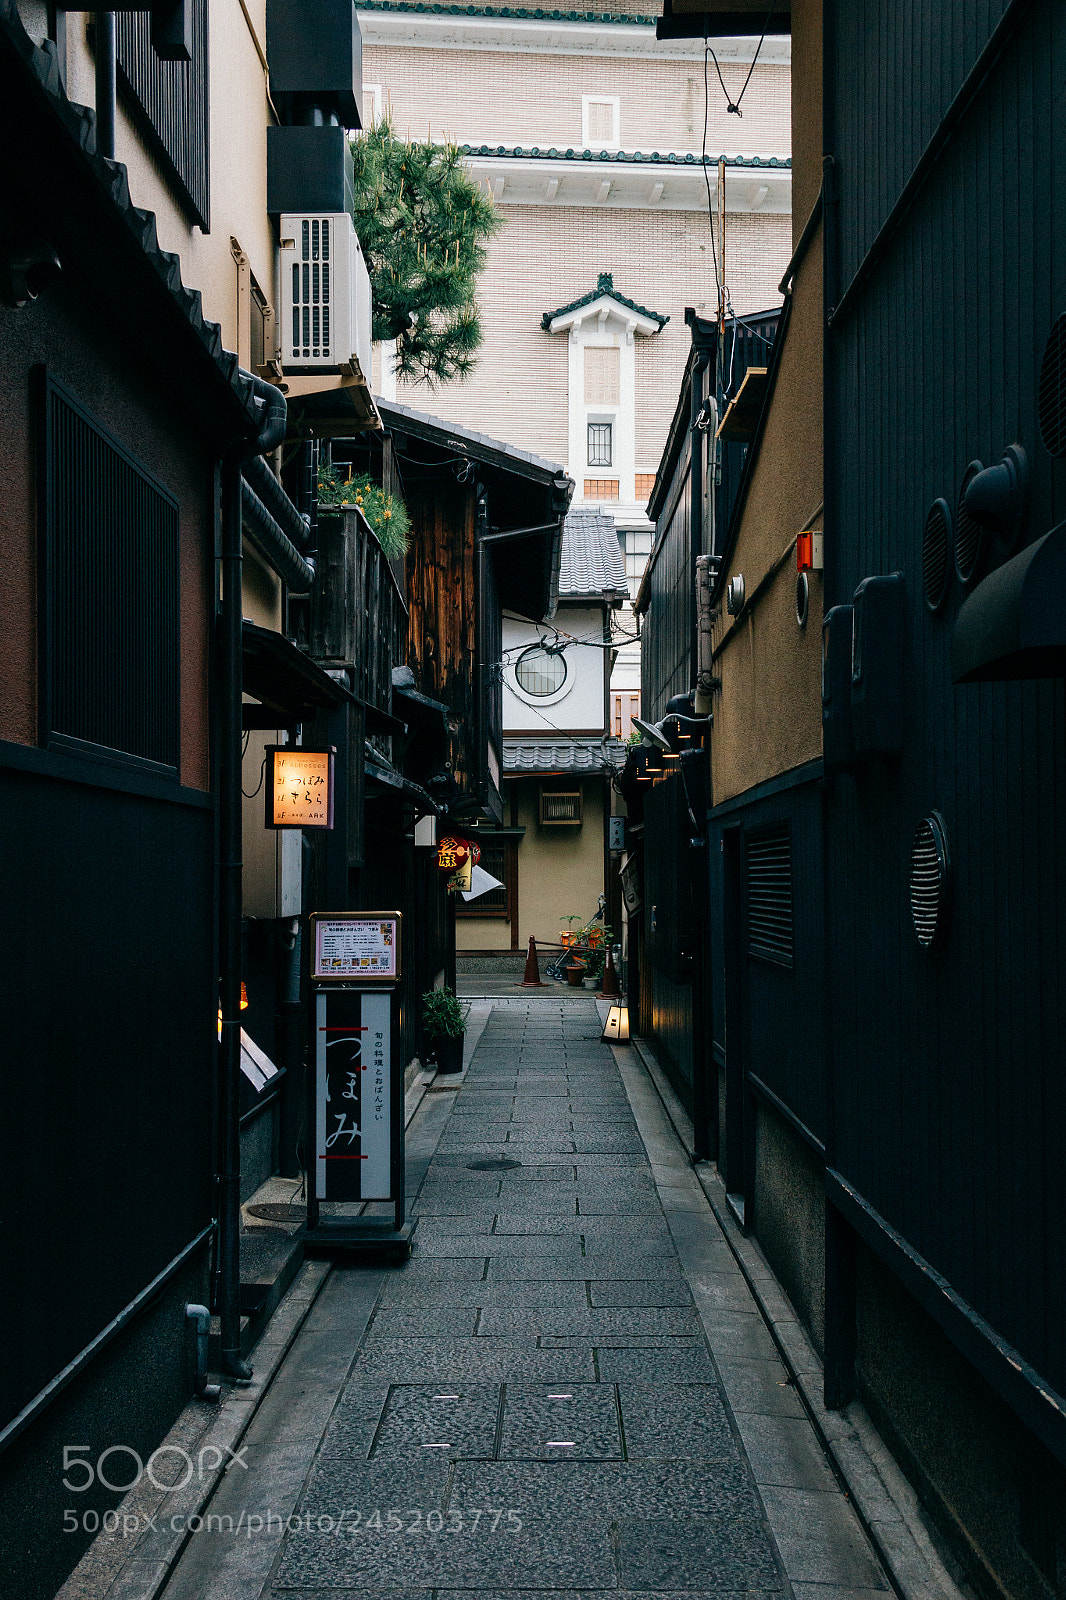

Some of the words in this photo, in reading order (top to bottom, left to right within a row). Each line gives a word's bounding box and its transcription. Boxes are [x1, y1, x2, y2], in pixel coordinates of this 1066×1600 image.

[290, 775, 325, 786] つぼみ
[290, 790, 322, 805] きらら
[438, 837, 458, 868] 多麻
[374, 1031, 383, 1121] 旬の料理とおばんざい
[326, 1038, 367, 1148] つぼみ
